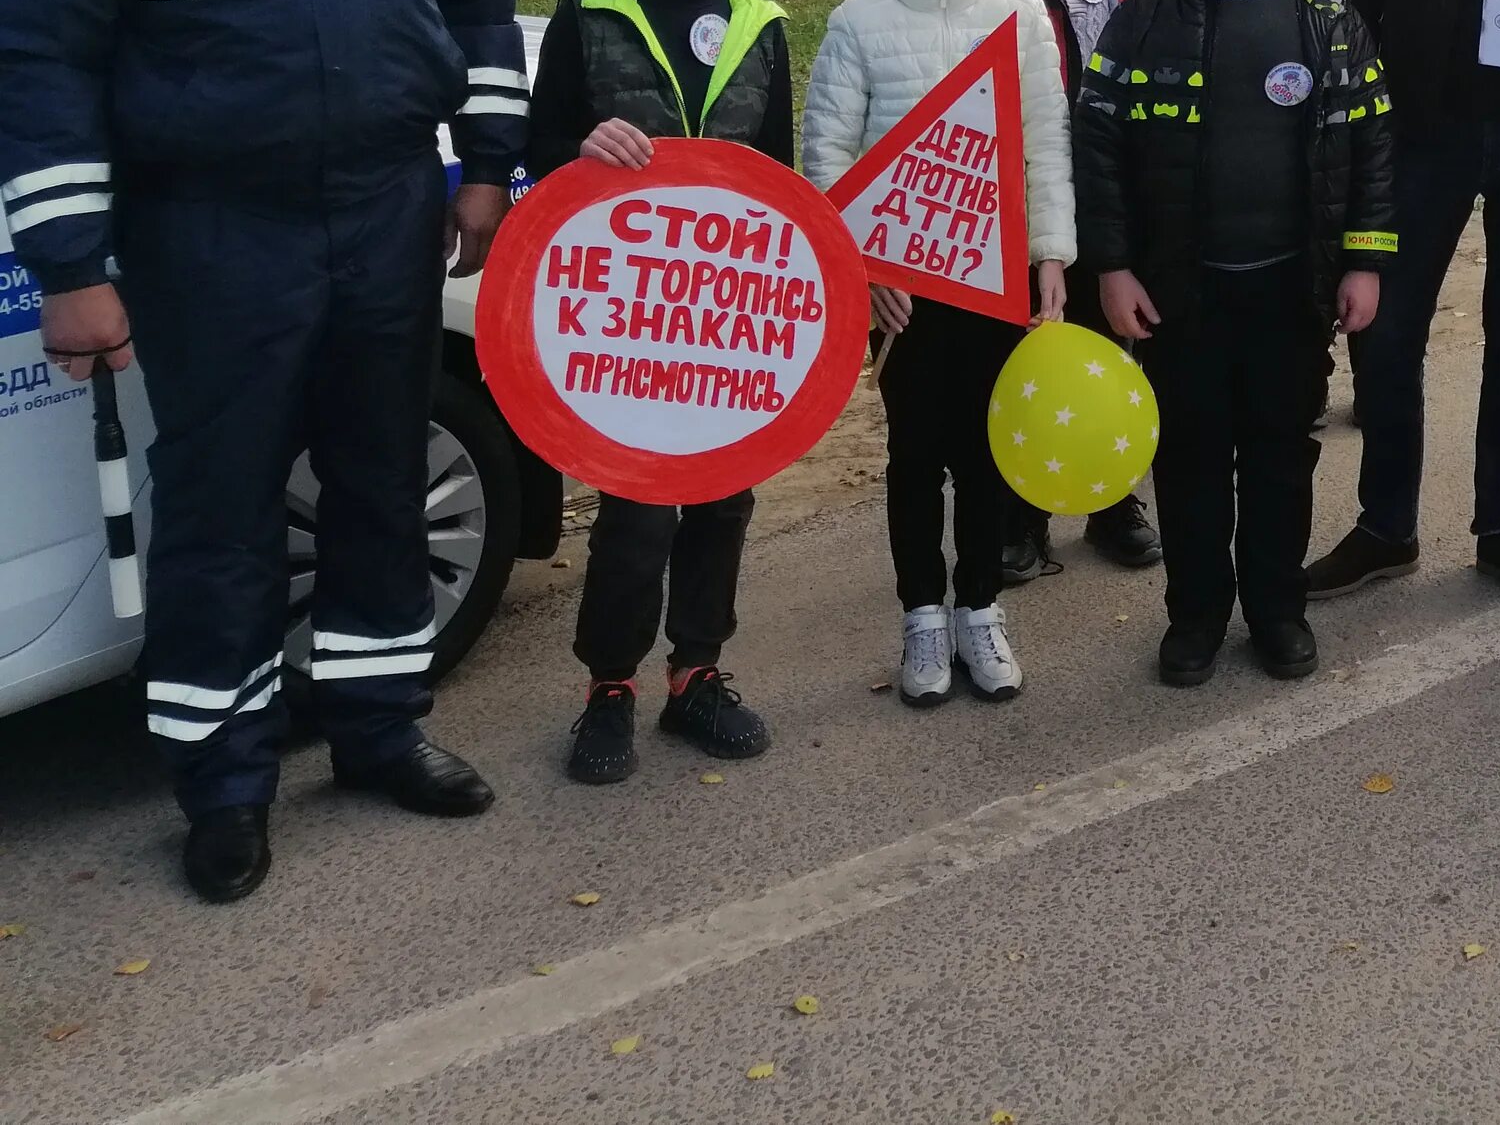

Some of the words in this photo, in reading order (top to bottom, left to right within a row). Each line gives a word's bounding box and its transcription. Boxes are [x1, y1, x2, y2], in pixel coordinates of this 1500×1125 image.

[915, 119, 998, 173] ДЕТИ
[891, 152, 998, 214] ПРОТИВ
[609, 199, 795, 270] СТОЙ!
[871, 188, 994, 248] ДТП!
[1348, 236, 1373, 245] ЮИД
[863, 222, 888, 256] А
[903, 233, 984, 281] ВЫ?
[545, 245, 612, 293] НЕ
[626, 254, 823, 324] ТОРОПИСЬ
[557, 296, 589, 336] К
[601, 297, 796, 360] ЗНАКАМ
[24, 387, 87, 410] области
[564, 351, 785, 413] ПРИСМОТРИСЬ
